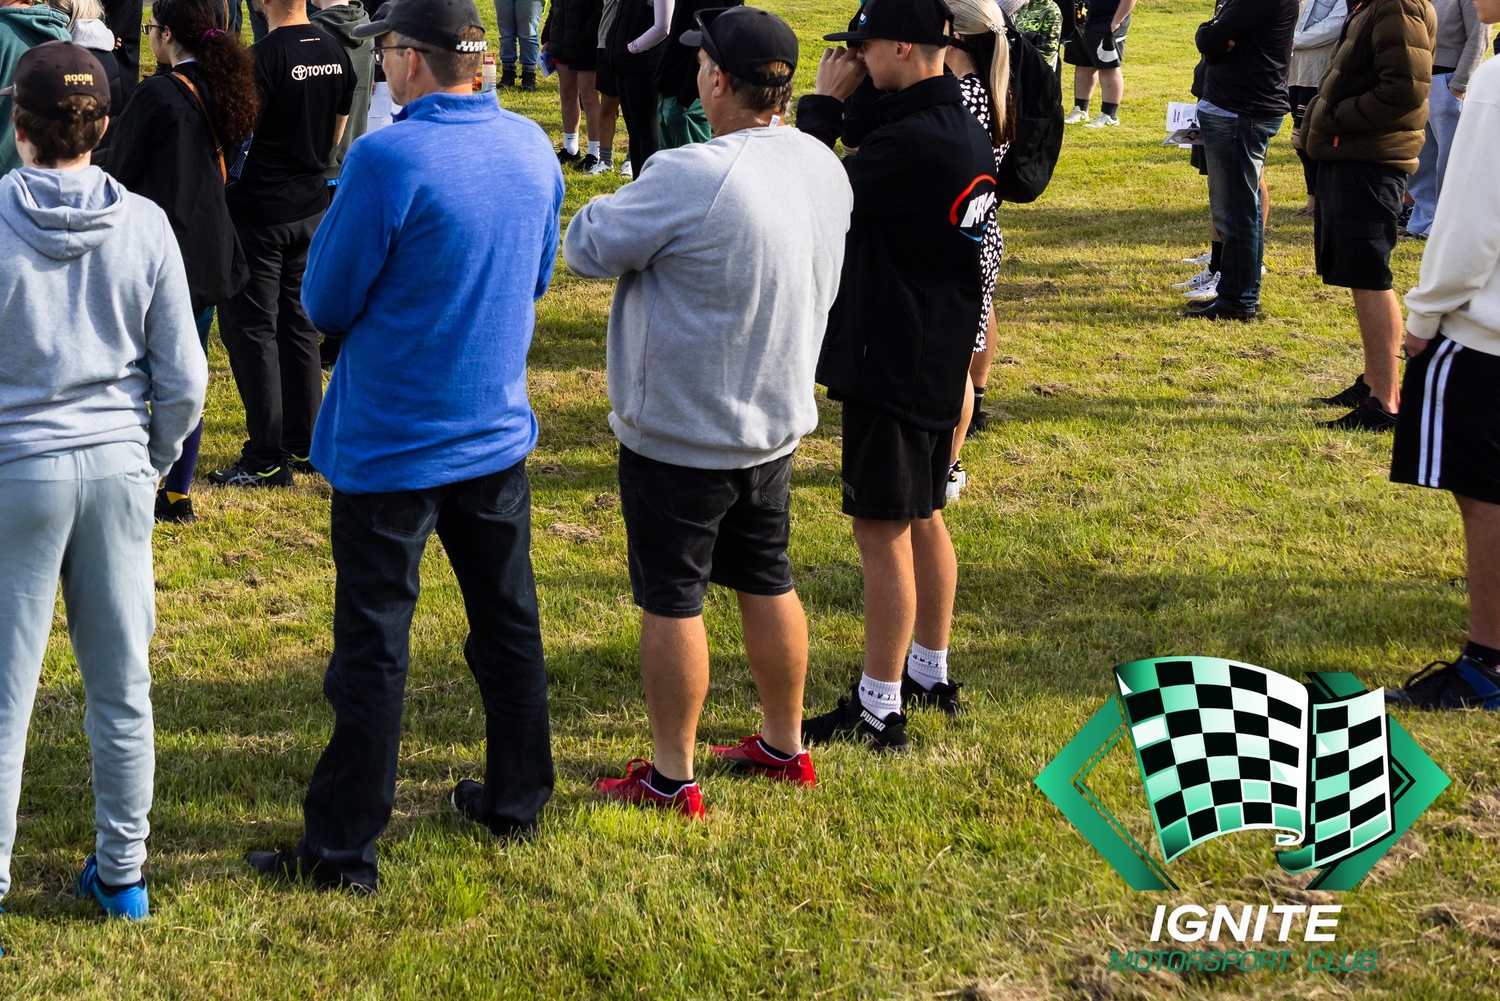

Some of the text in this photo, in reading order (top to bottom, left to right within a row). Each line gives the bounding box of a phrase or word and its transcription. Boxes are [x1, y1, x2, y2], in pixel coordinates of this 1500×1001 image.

[307, 64, 343, 77] TOYOTA
[64, 74, 93, 82] RODIN
[860, 709, 886, 732] PUMA
